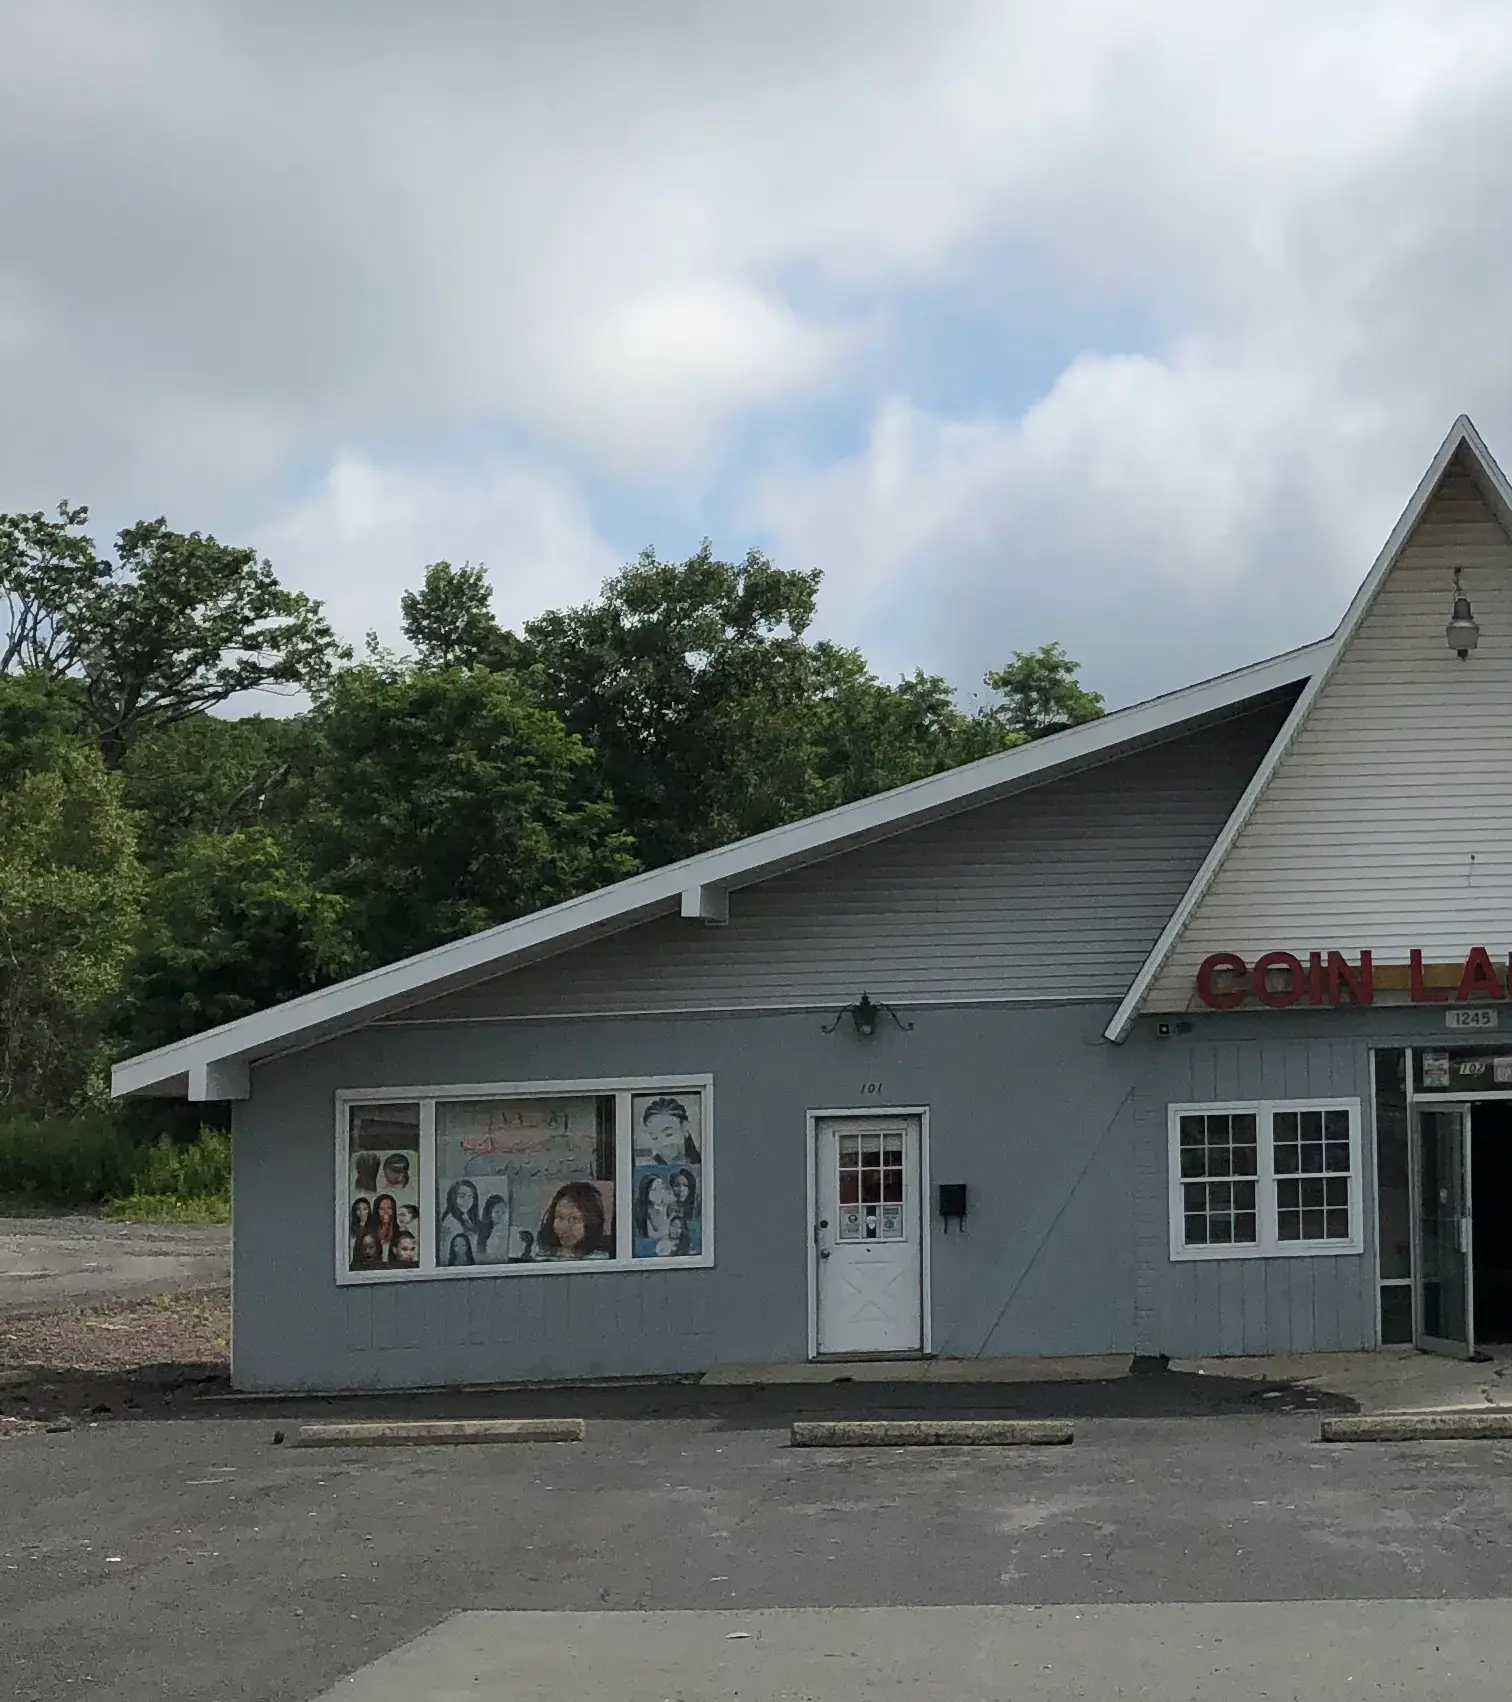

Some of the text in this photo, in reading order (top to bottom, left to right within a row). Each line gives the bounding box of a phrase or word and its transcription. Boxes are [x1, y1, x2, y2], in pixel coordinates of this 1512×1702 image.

[1198, 949, 1373, 1009] COIN
[1455, 1011, 1492, 1026] 1245
[1461, 1062, 1485, 1075] 102
[860, 1083, 884, 1095] 101
